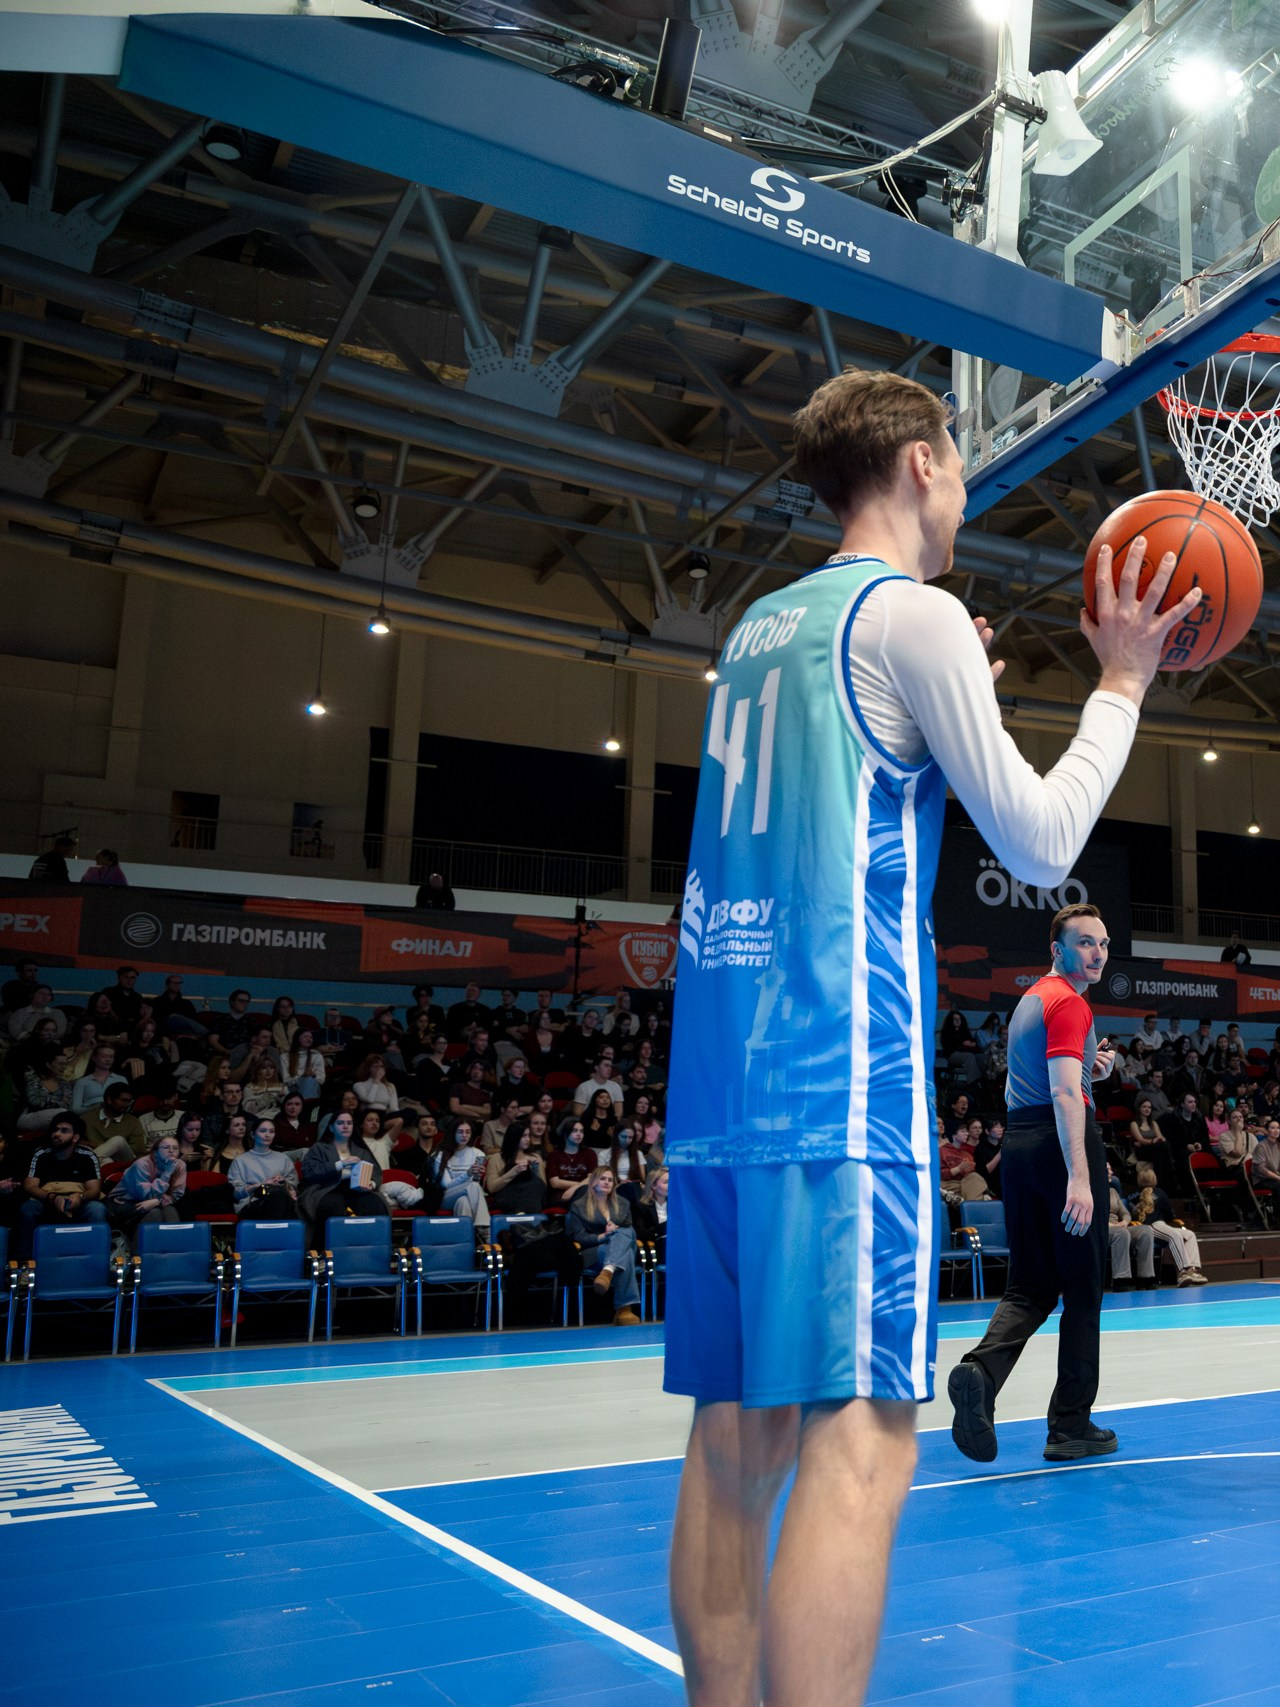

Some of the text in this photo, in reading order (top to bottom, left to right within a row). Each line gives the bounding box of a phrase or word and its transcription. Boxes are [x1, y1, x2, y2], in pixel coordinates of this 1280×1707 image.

[667, 174, 871, 264] Schelde Sports
[707, 666, 782, 839] 41
[706, 898, 775, 933] ДВФУ
[172, 922, 327, 949] ГАЗПРОМБАНК
[390, 937, 474, 958] ФИНАЛ
[631, 940, 668, 958] КУБОК
[1135, 980, 1219, 998] ГАЗПРОМБАНК
